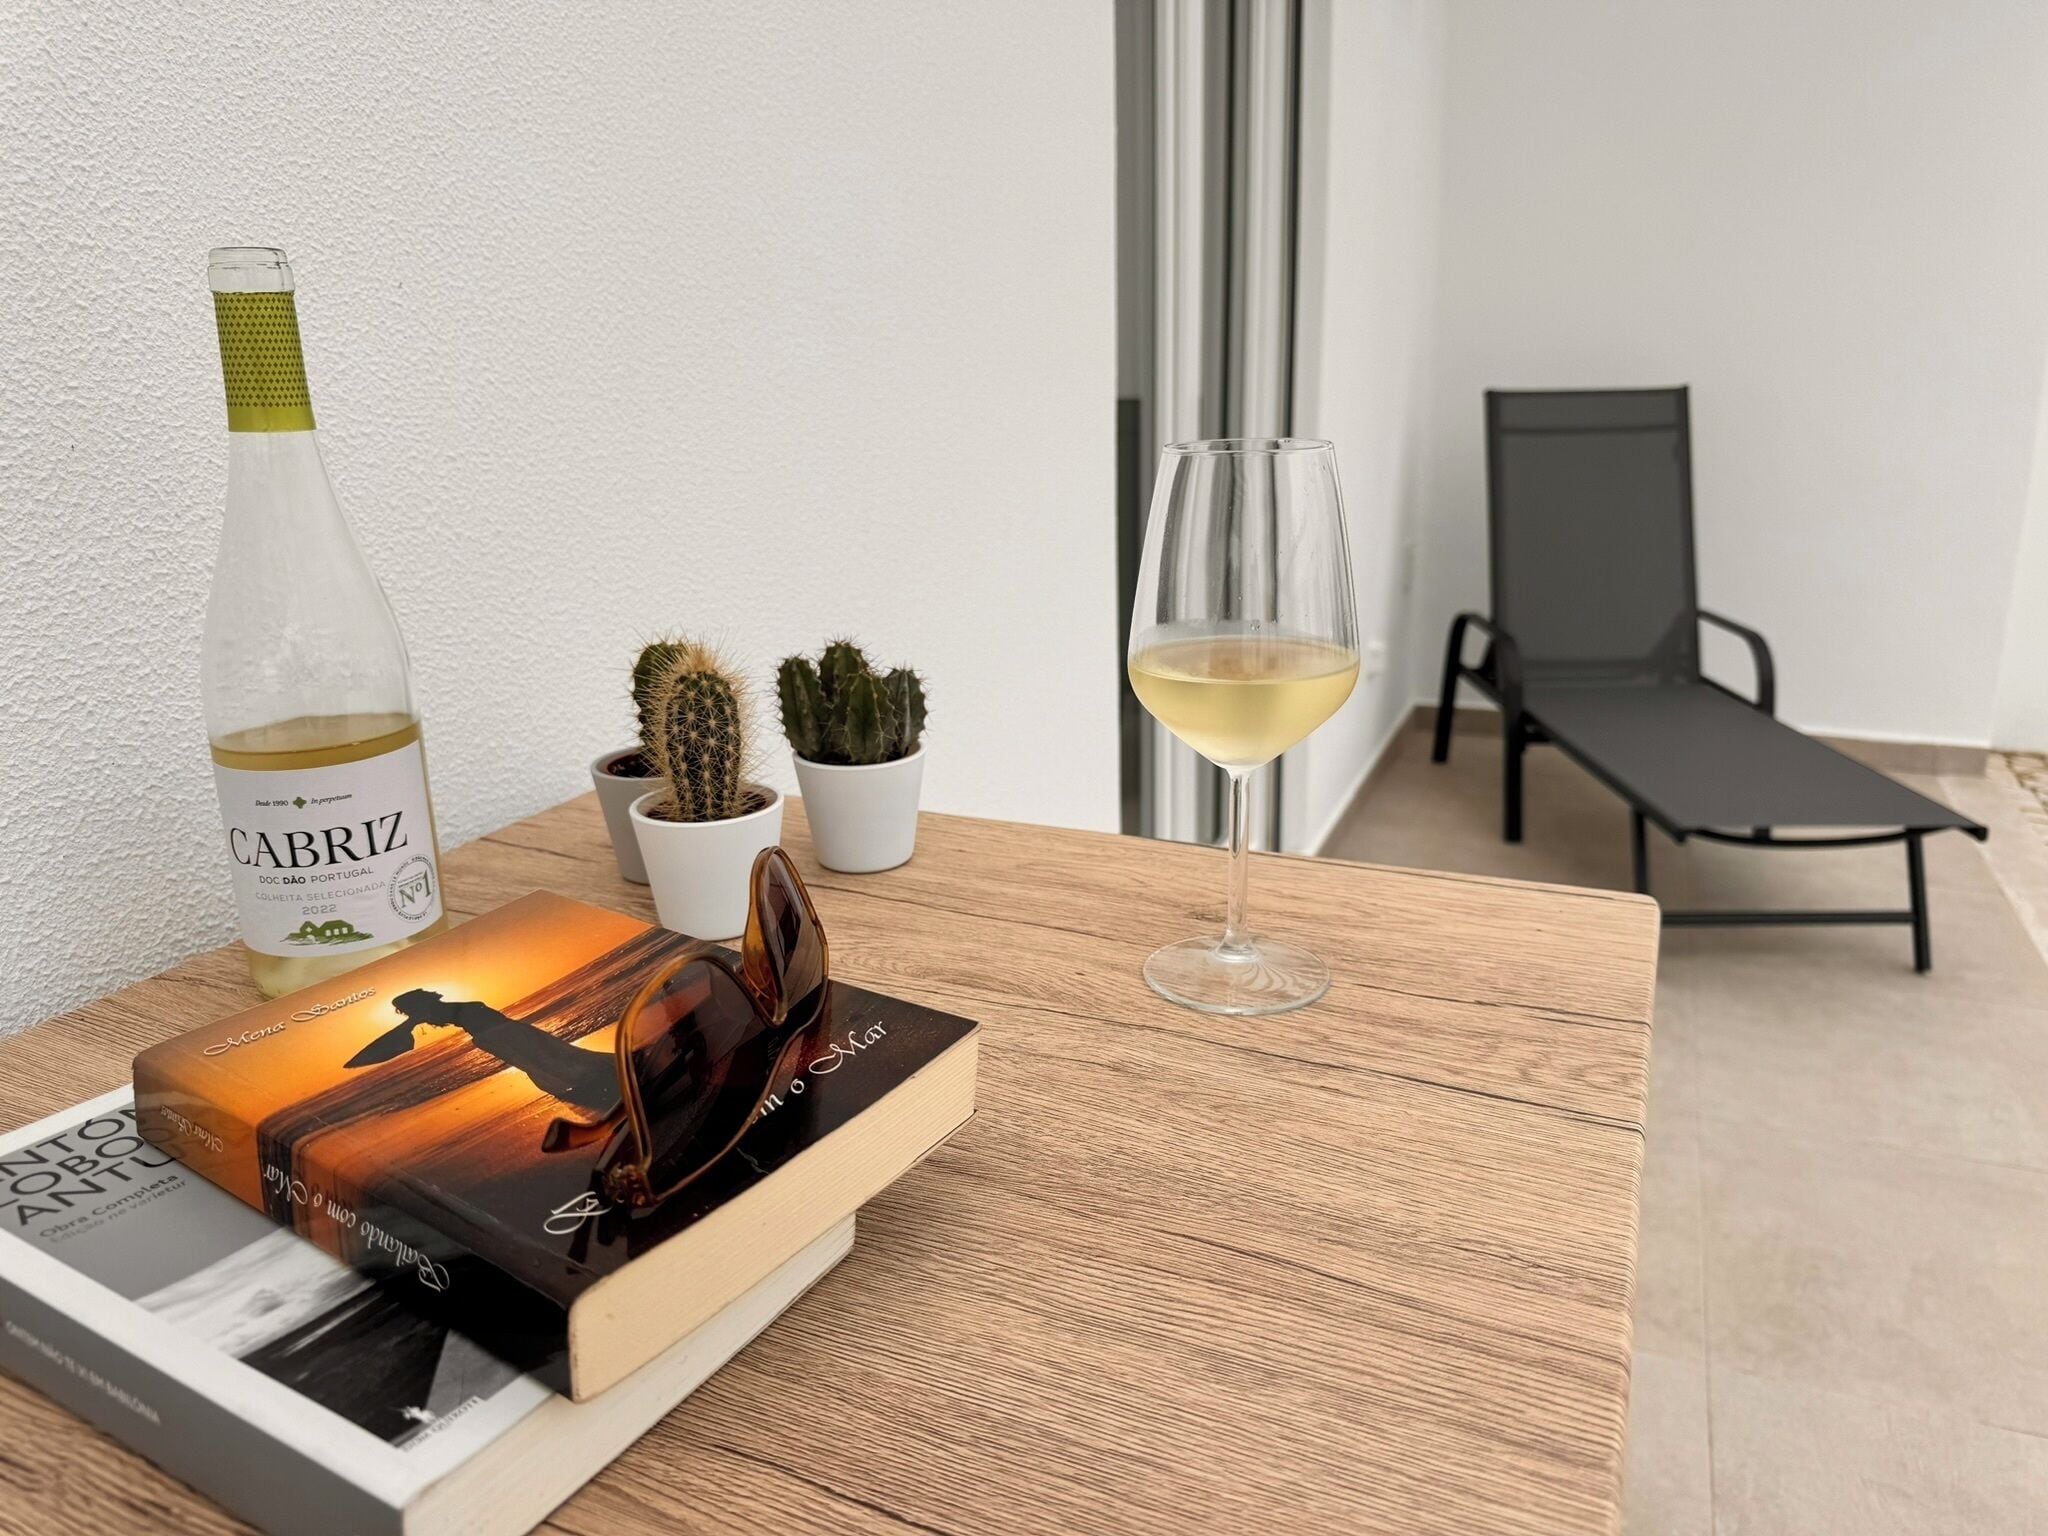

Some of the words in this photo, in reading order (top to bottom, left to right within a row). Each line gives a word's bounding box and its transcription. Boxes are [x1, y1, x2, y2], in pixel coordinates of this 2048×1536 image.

[272, 799, 289, 807] 1990
[230, 811, 408, 868] CABRIZ
[256, 892, 302, 903] COLHEITA
[306, 881, 386, 902] SELECIONADA
[259, 875, 280, 885] DOC
[283, 874, 306, 885] DÃO
[311, 866, 374, 883] PORTUGAL
[302, 904, 337, 916] 2022
[204, 1021, 286, 1056] Mena
[290, 986, 377, 1022] Santos
[790, 1078, 805, 1094] o
[808, 1020, 887, 1074] Mar
[0, 1136, 144, 1209] OBO
[17, 1157, 176, 1226] ANTU
[263, 1164, 308, 1205] Mar
[40, 1215, 89, 1238] Obra
[92, 1174, 179, 1217] Completa
[313, 1192, 323, 1208] o
[326, 1199, 356, 1228] com
[360, 1221, 450, 1292] Bailando
